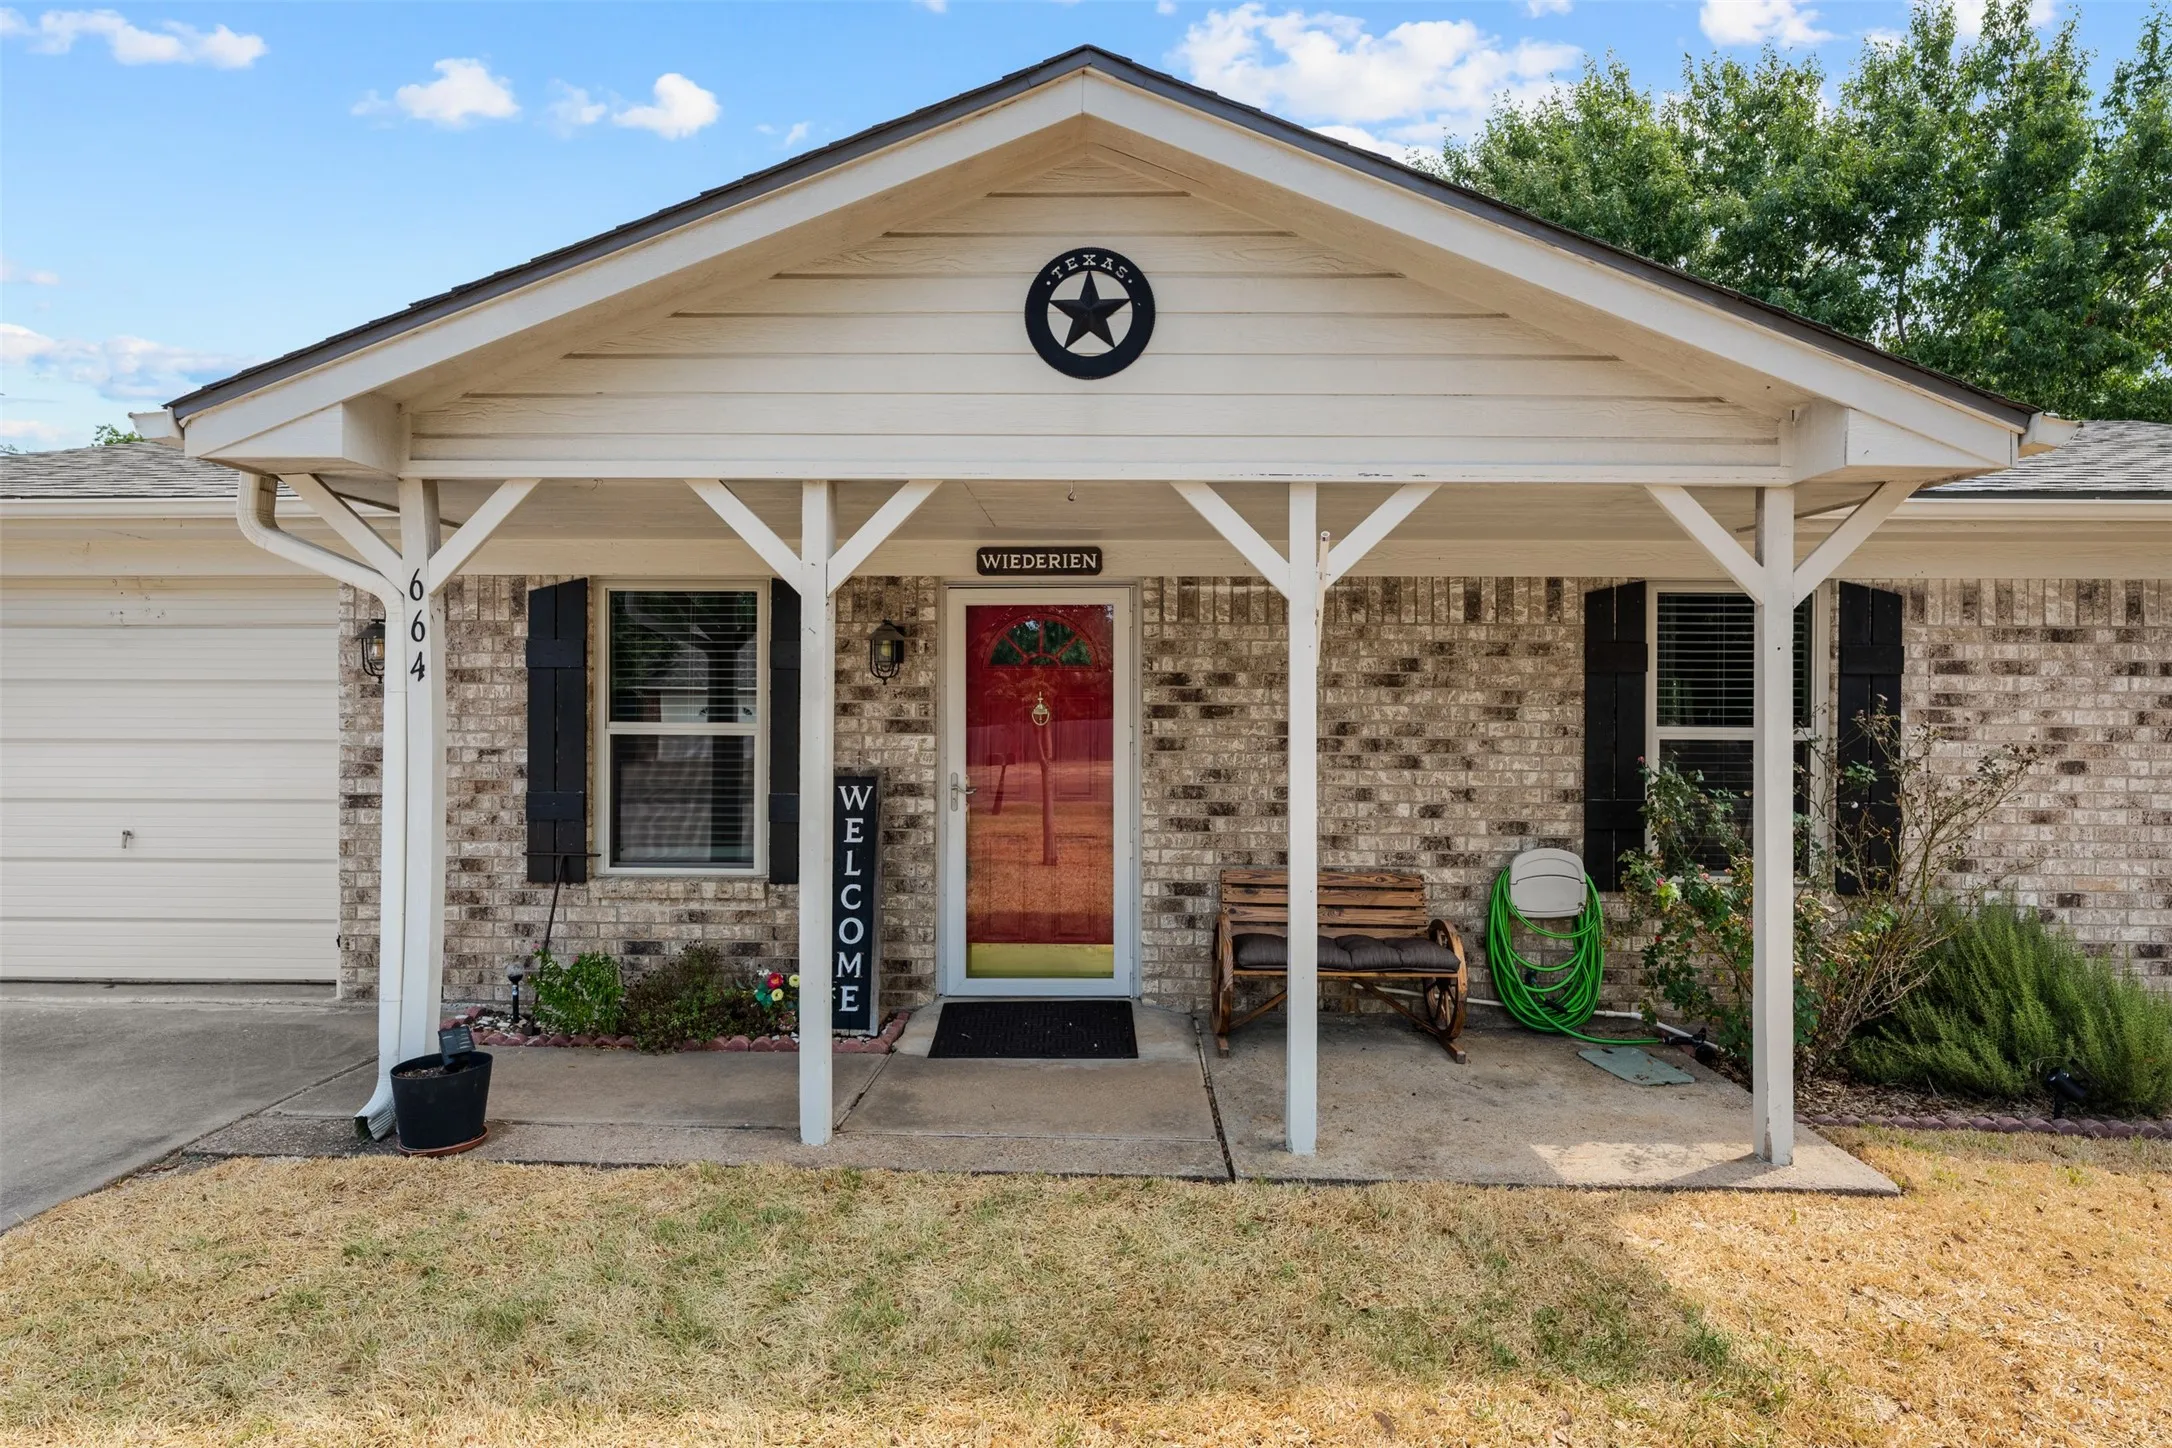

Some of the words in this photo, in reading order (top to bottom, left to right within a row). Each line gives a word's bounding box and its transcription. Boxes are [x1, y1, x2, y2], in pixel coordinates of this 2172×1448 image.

[1051, 254, 1128, 279] TEXAS
[980, 553, 1097, 569] WIEDERIEN
[409, 568, 425, 682] 664
[835, 785, 873, 1012] WELCOME
